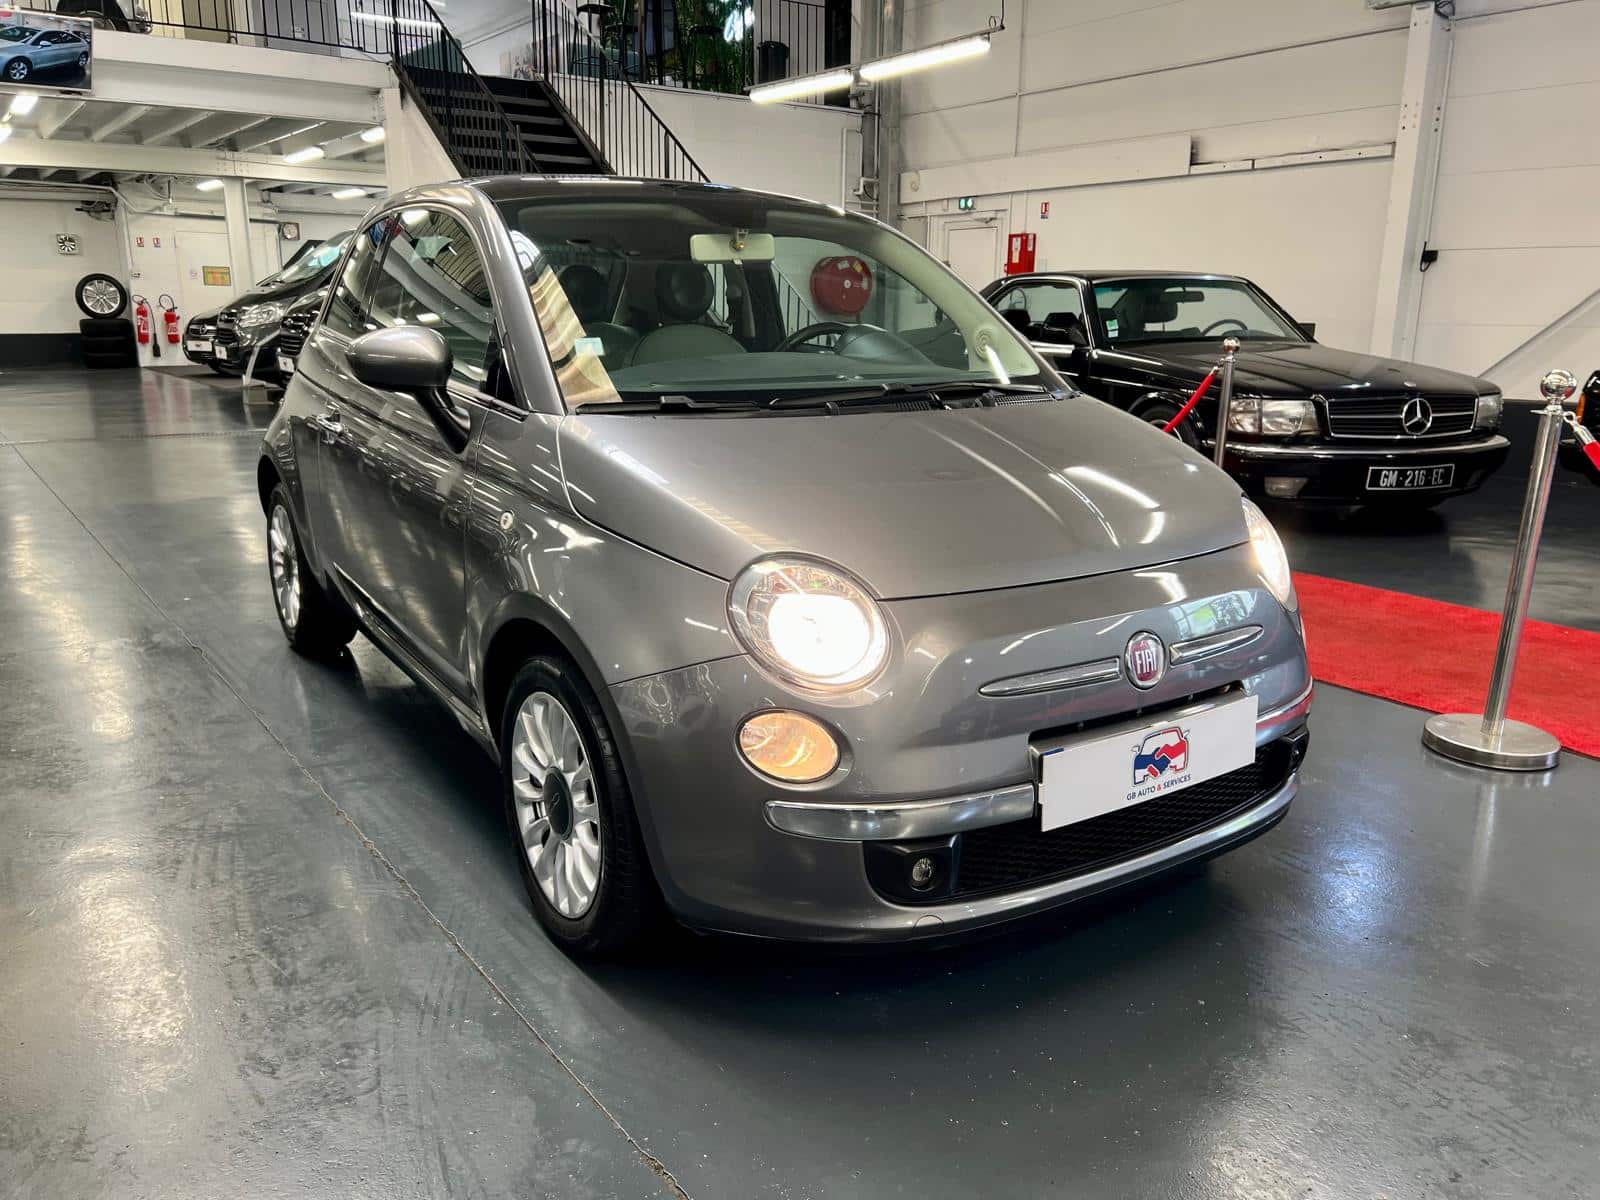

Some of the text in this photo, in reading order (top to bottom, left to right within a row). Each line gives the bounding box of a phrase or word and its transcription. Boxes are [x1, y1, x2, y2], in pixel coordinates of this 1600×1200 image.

[1135, 648, 1157, 674] FIAT
[1127, 792, 1136, 800] GB
[1138, 786, 1155, 797] AUTO
[1163, 774, 1190, 789] SERVICES
